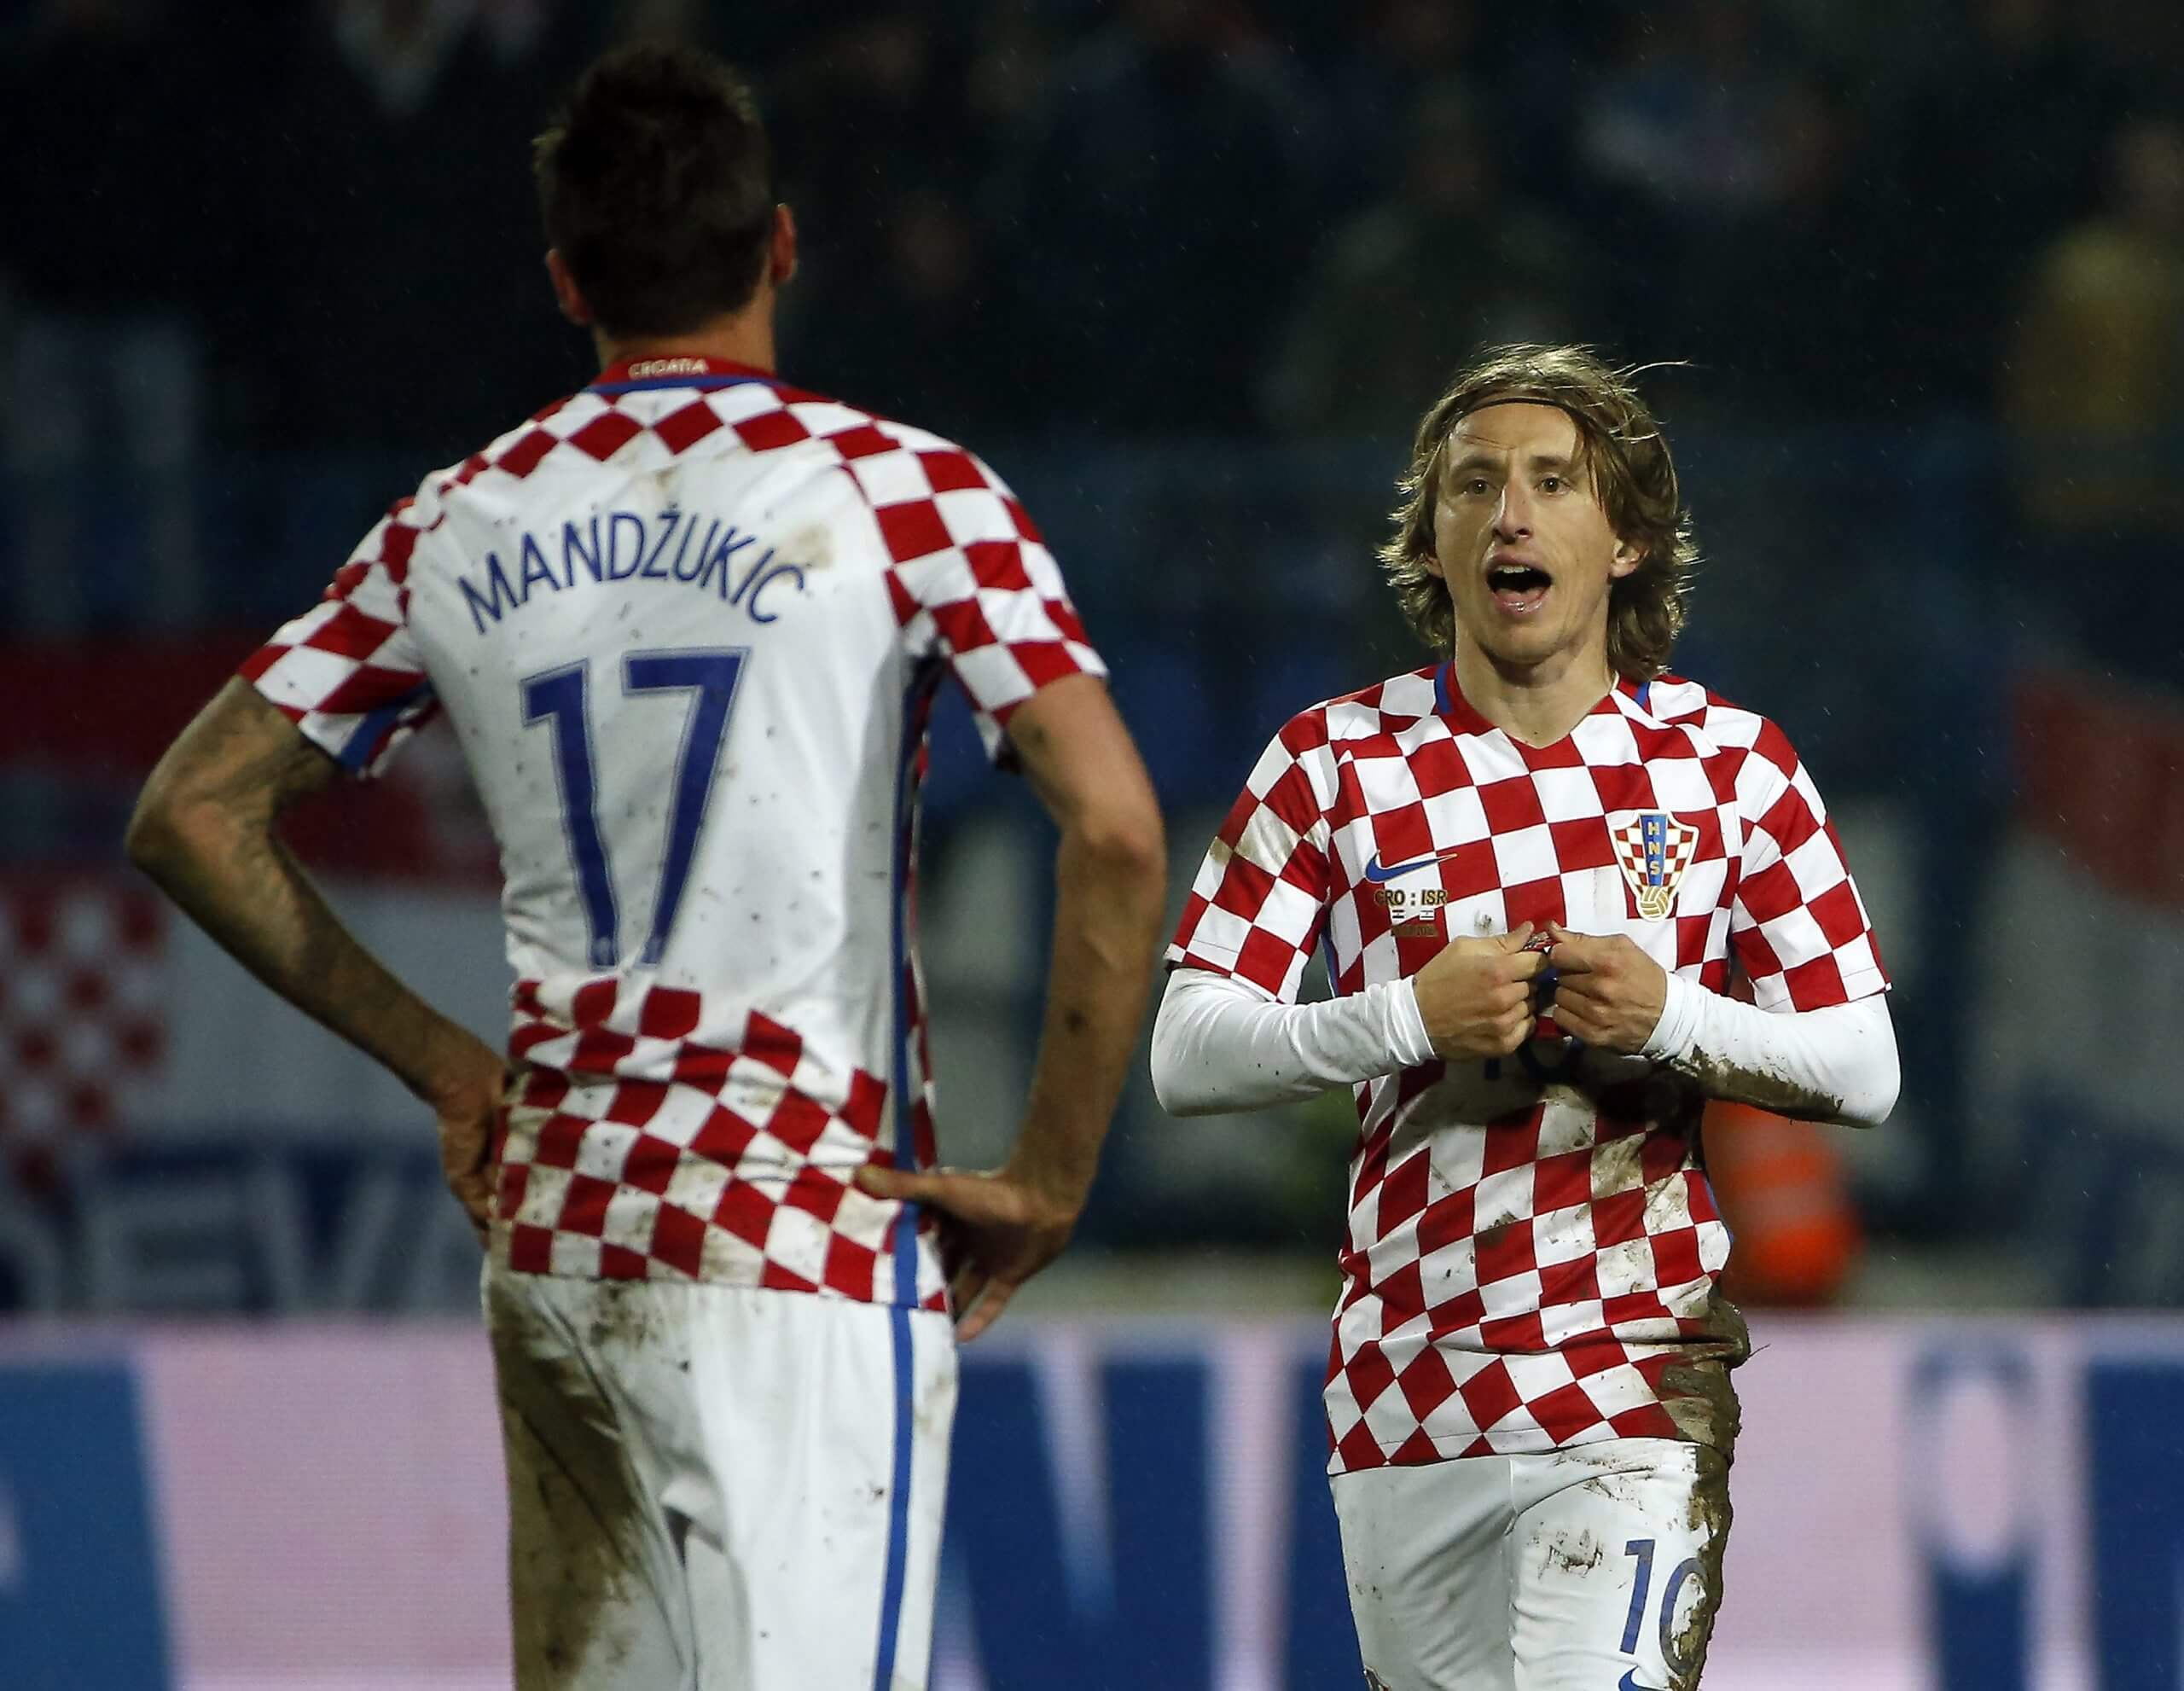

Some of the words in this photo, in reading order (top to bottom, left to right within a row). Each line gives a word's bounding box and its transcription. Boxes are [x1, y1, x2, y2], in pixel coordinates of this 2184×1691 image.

[627, 357, 710, 381] CROATIA
[519, 646, 752, 971] 17
[1647, 821, 1662, 875] HNS
[1374, 888, 1406, 907] CRO
[1420, 889, 1449, 906] ISR
